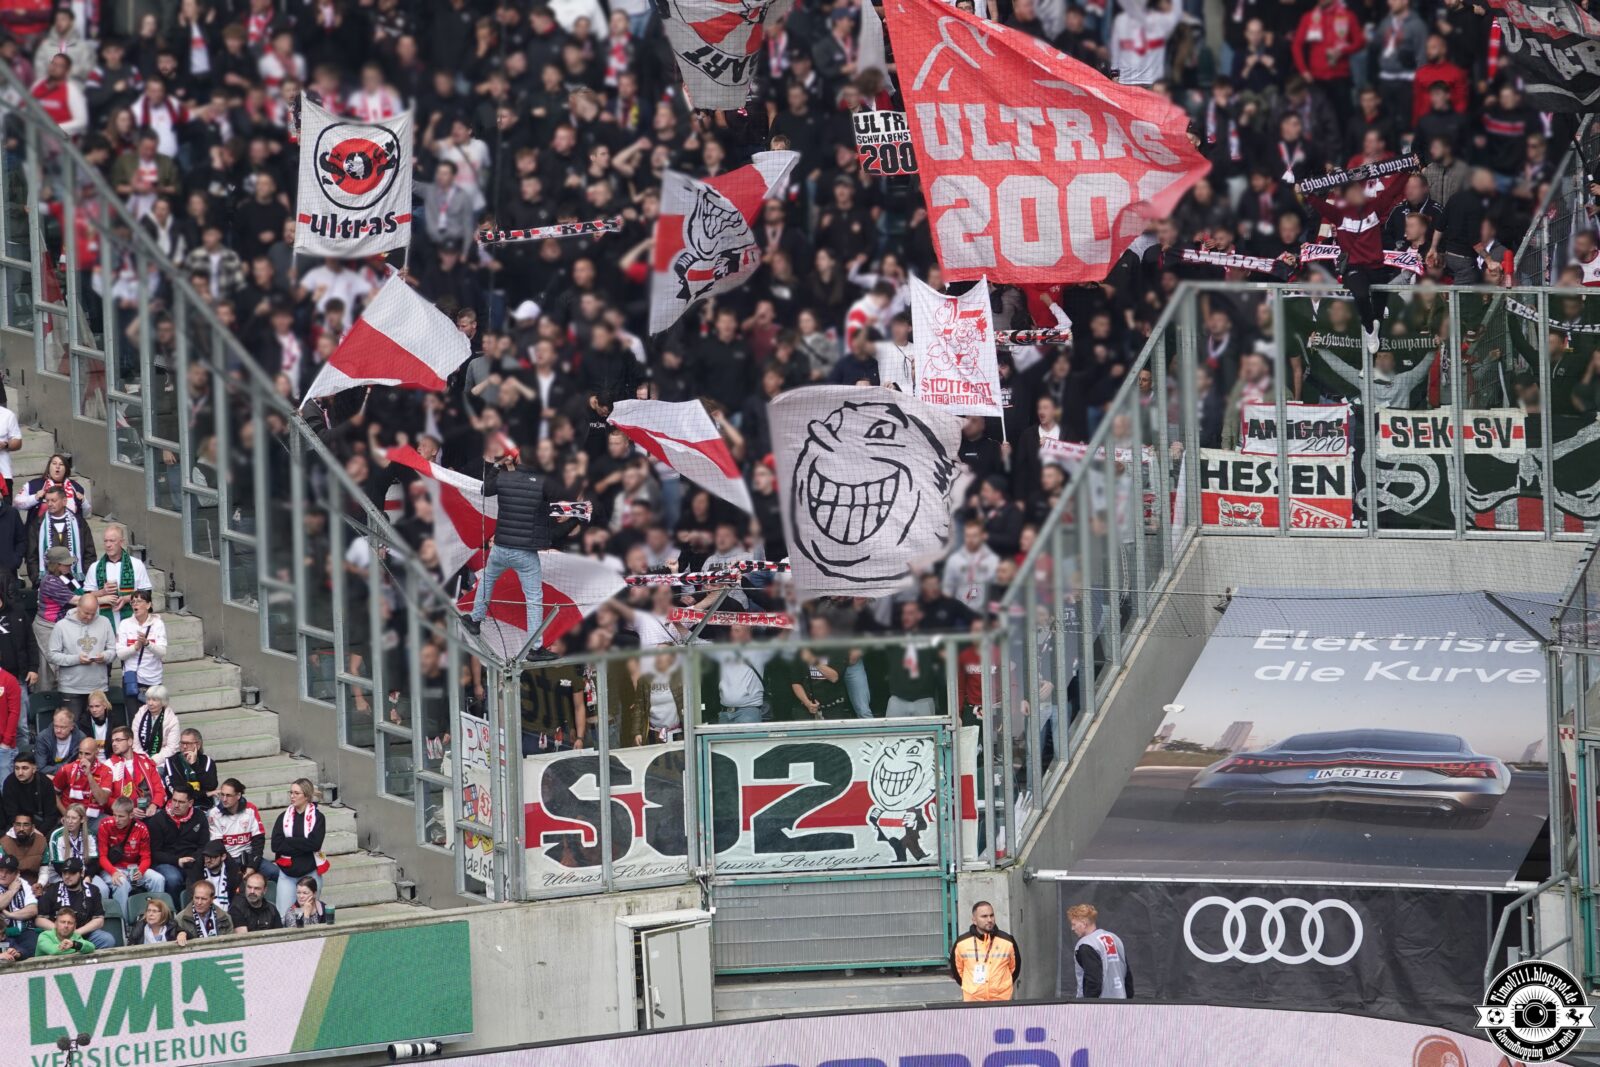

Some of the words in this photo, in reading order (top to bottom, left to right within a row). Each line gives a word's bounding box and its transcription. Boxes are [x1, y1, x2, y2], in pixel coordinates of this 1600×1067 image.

[853, 112, 909, 134] ULTR
[857, 132, 911, 144] SCHWABENS
[915, 103, 1180, 165] ULTRAS
[1298, 172, 1349, 193] chwaben
[1368, 156, 1415, 176] Kompan
[311, 211, 397, 239] ultras
[1301, 437, 1346, 452] 2010
[1390, 416, 1453, 448] SEK
[1473, 417, 1512, 448] SV
[1200, 459, 1346, 495] HESEN
[1254, 661, 1345, 682] die
[1364, 661, 1546, 684] Kurve
[1316, 770, 1334, 779] IN
[1341, 769, 1361, 777] GT
[543, 871, 601, 886] Ultras
[772, 853, 880, 869] Stuttgart
[29, 962, 173, 1045] LVM
[31, 1030, 247, 1067] VERSICHERUNG
